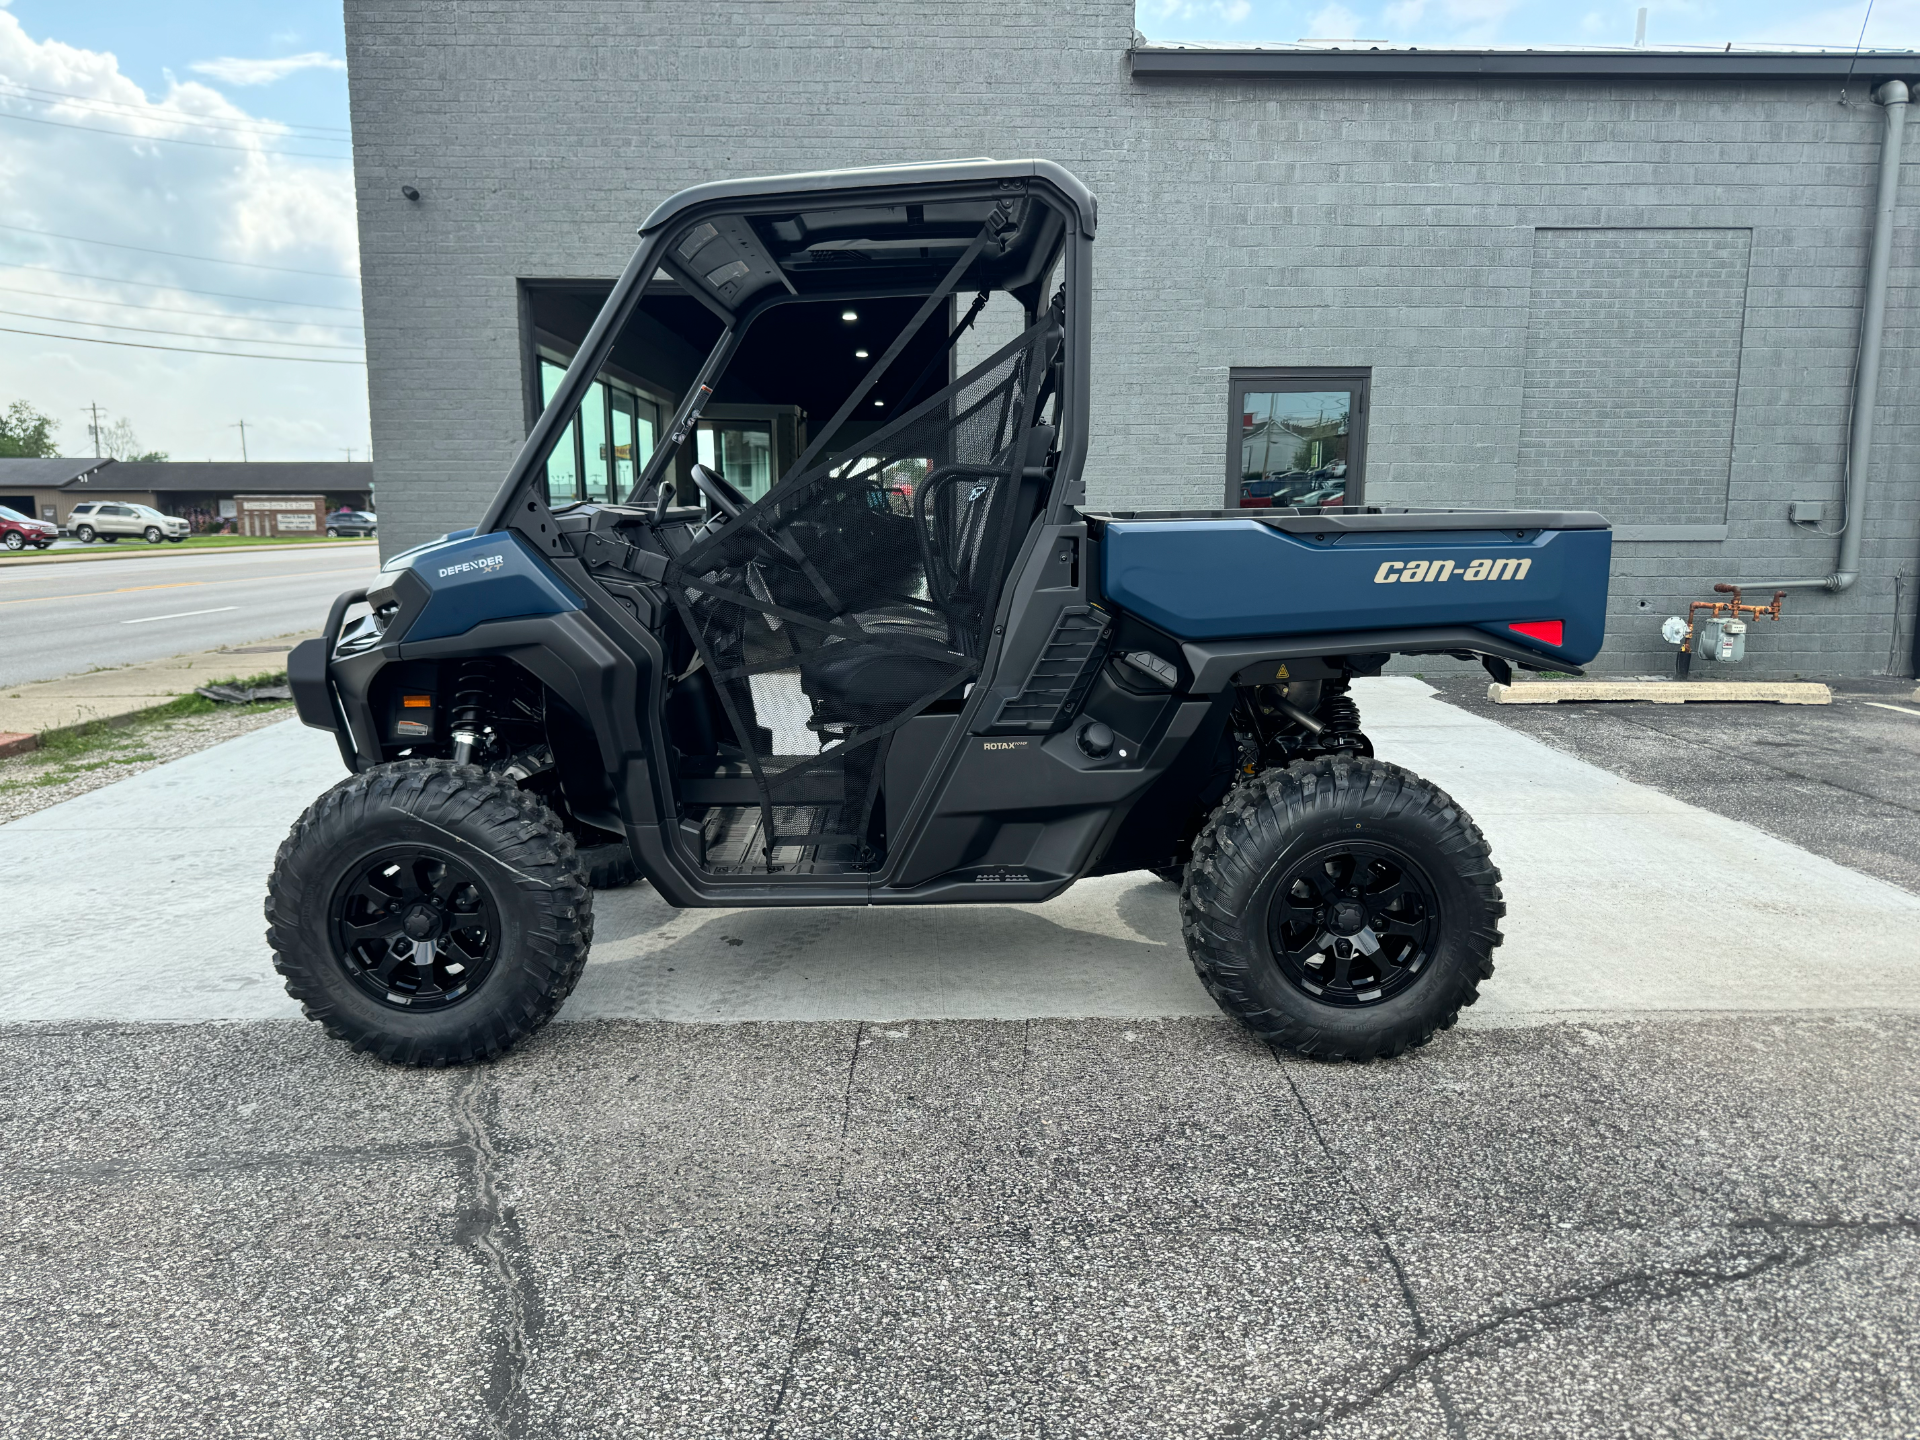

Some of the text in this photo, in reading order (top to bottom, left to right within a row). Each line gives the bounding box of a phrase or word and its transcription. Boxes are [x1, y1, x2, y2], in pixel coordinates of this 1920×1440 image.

[439, 555, 504, 578] DEFENDER
[482, 563, 504, 574] XT
[1373, 558, 1532, 584] can-am
[983, 742, 1015, 750] ROTAX
